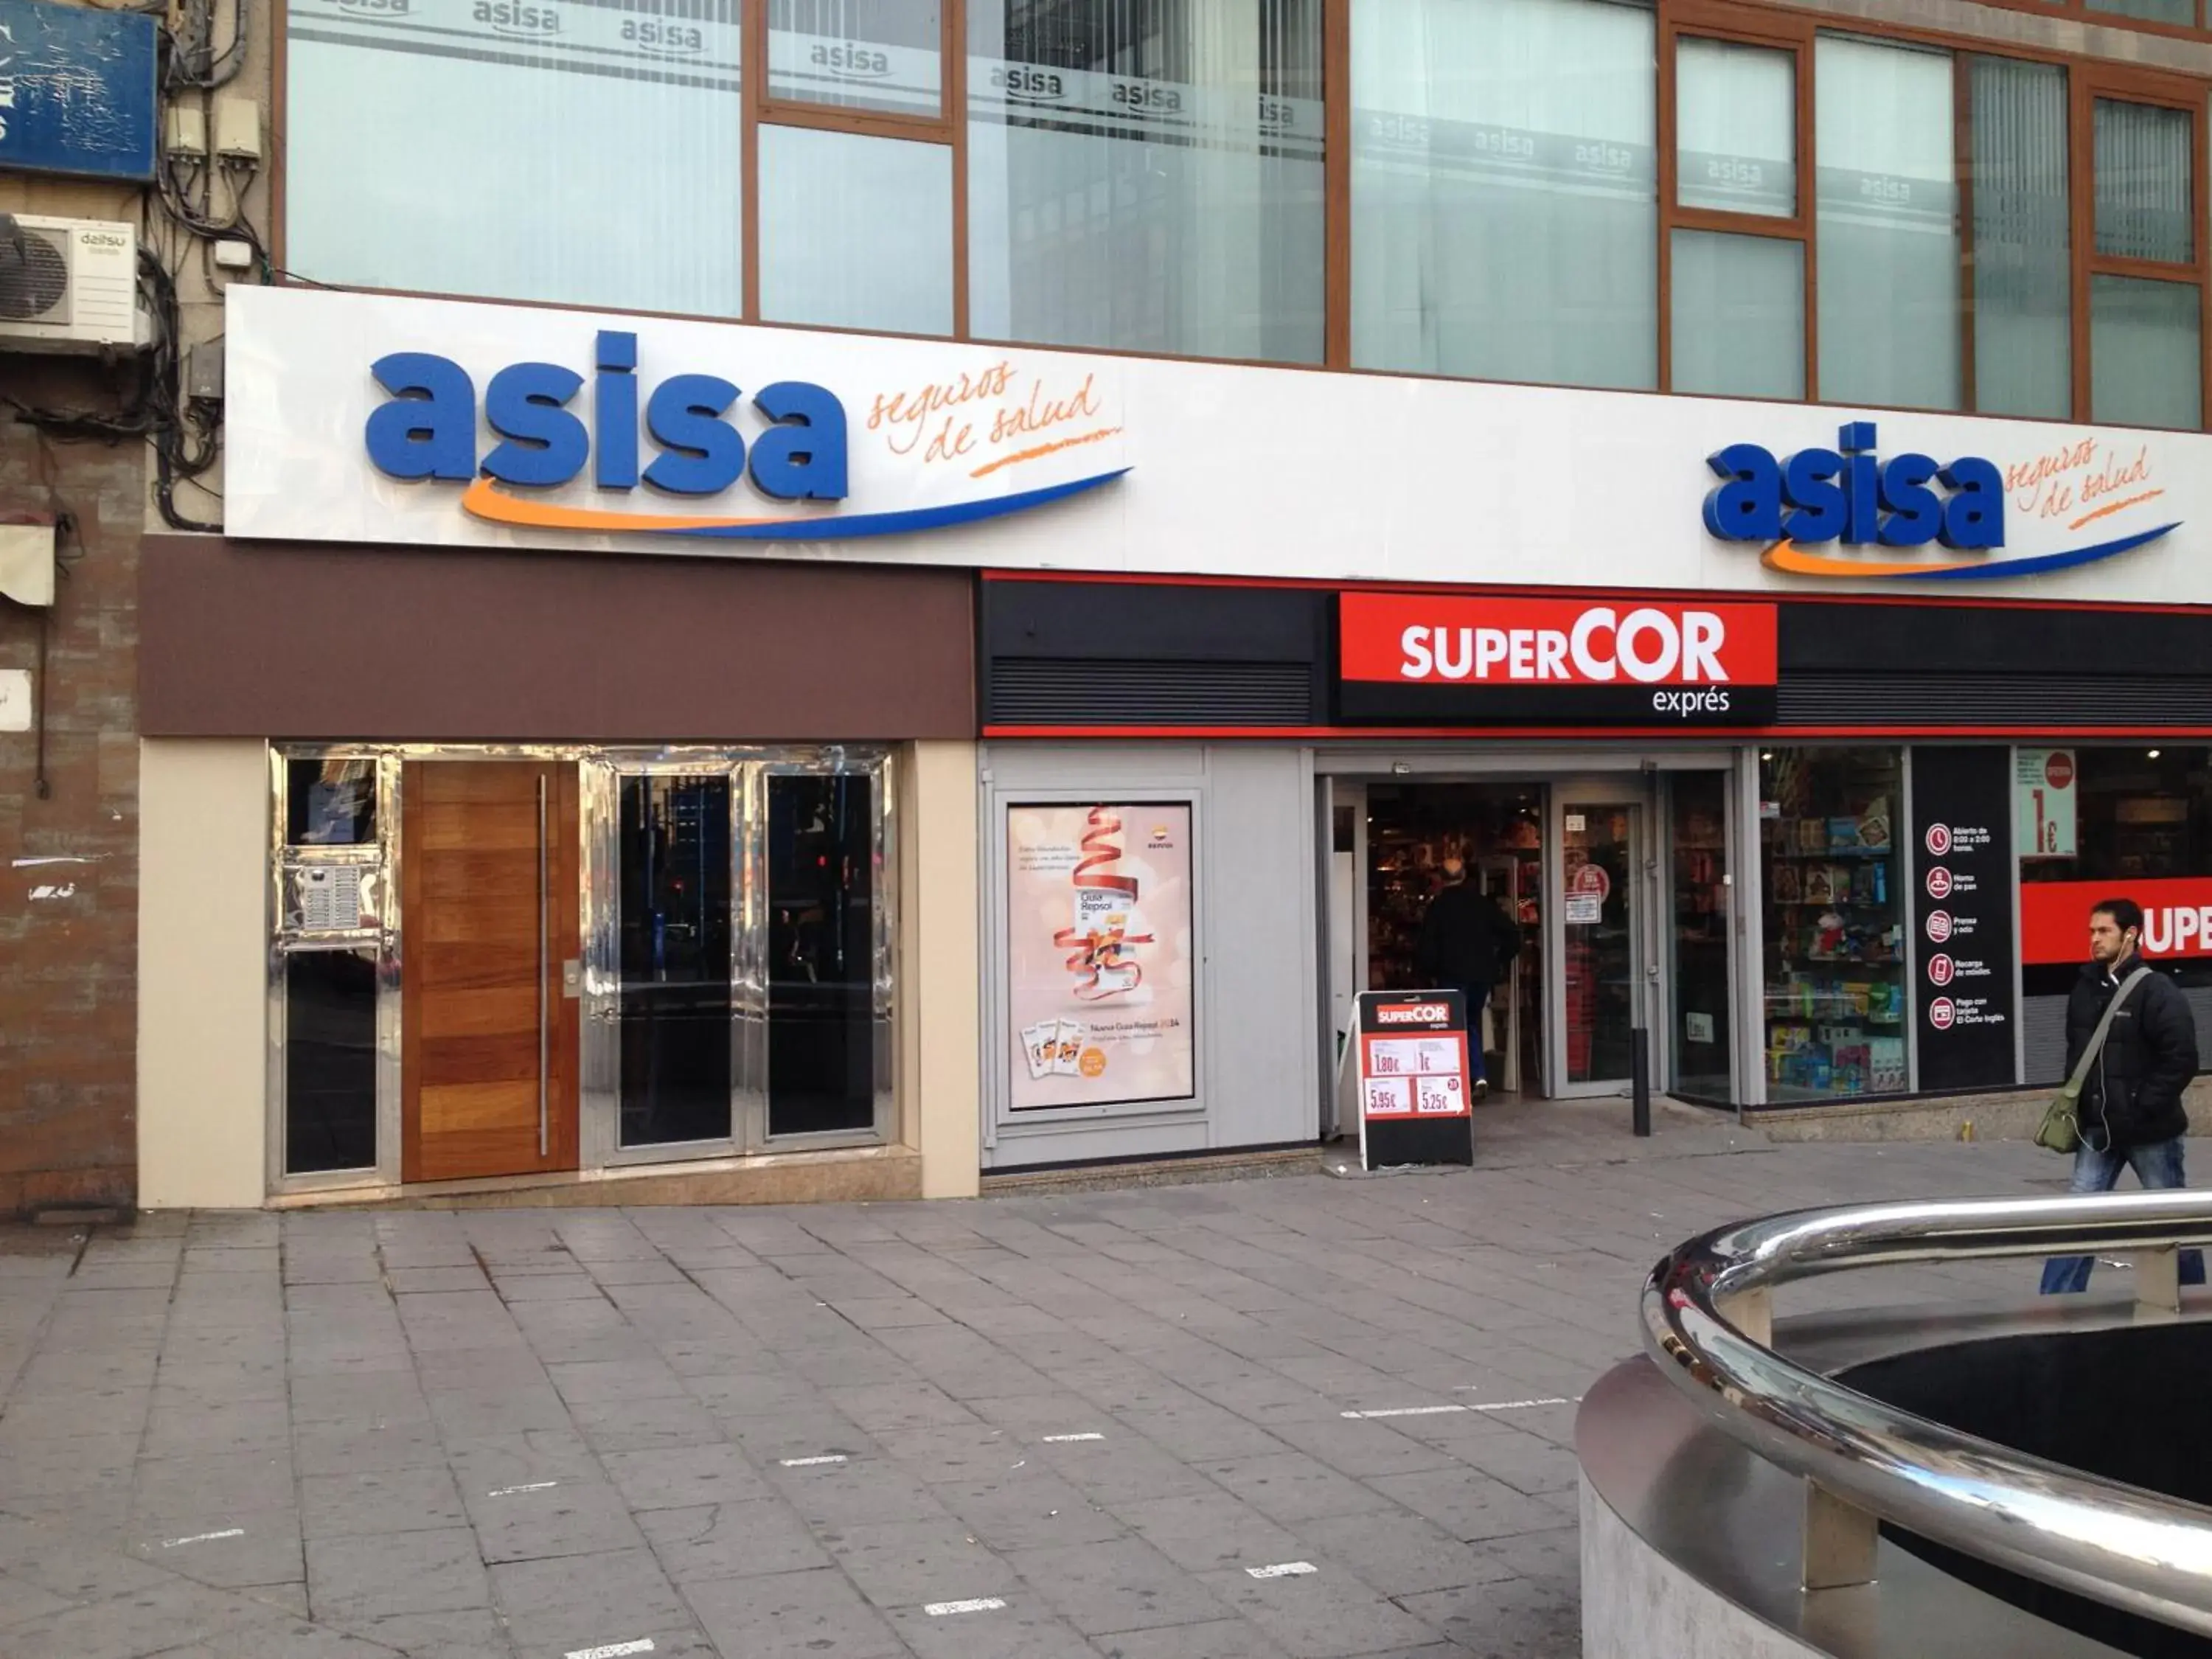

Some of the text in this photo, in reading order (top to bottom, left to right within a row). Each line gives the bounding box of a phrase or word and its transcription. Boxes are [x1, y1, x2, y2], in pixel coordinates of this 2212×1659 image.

[473, 1, 559, 31] asisa
[621, 18, 703, 49] asisa
[811, 42, 888, 73] asisa
[991, 66, 1062, 95] asisa
[1112, 77, 1181, 110] asisa
[1576, 142, 1632, 168] asisa
[1708, 158, 1762, 182] asisa
[1860, 177, 1910, 201] asisa
[365, 330, 848, 501] asisa
[867, 361, 1018, 453] seguros
[924, 373, 1101, 463] de salud
[1703, 421, 2004, 549] asisa
[2006, 437, 2097, 512] seguros
[2040, 445, 2152, 519] de salud
[1401, 607, 1730, 683] SUPERCOR
[1652, 686, 1731, 717] exprés
[2138, 906, 2212, 953] UPE
